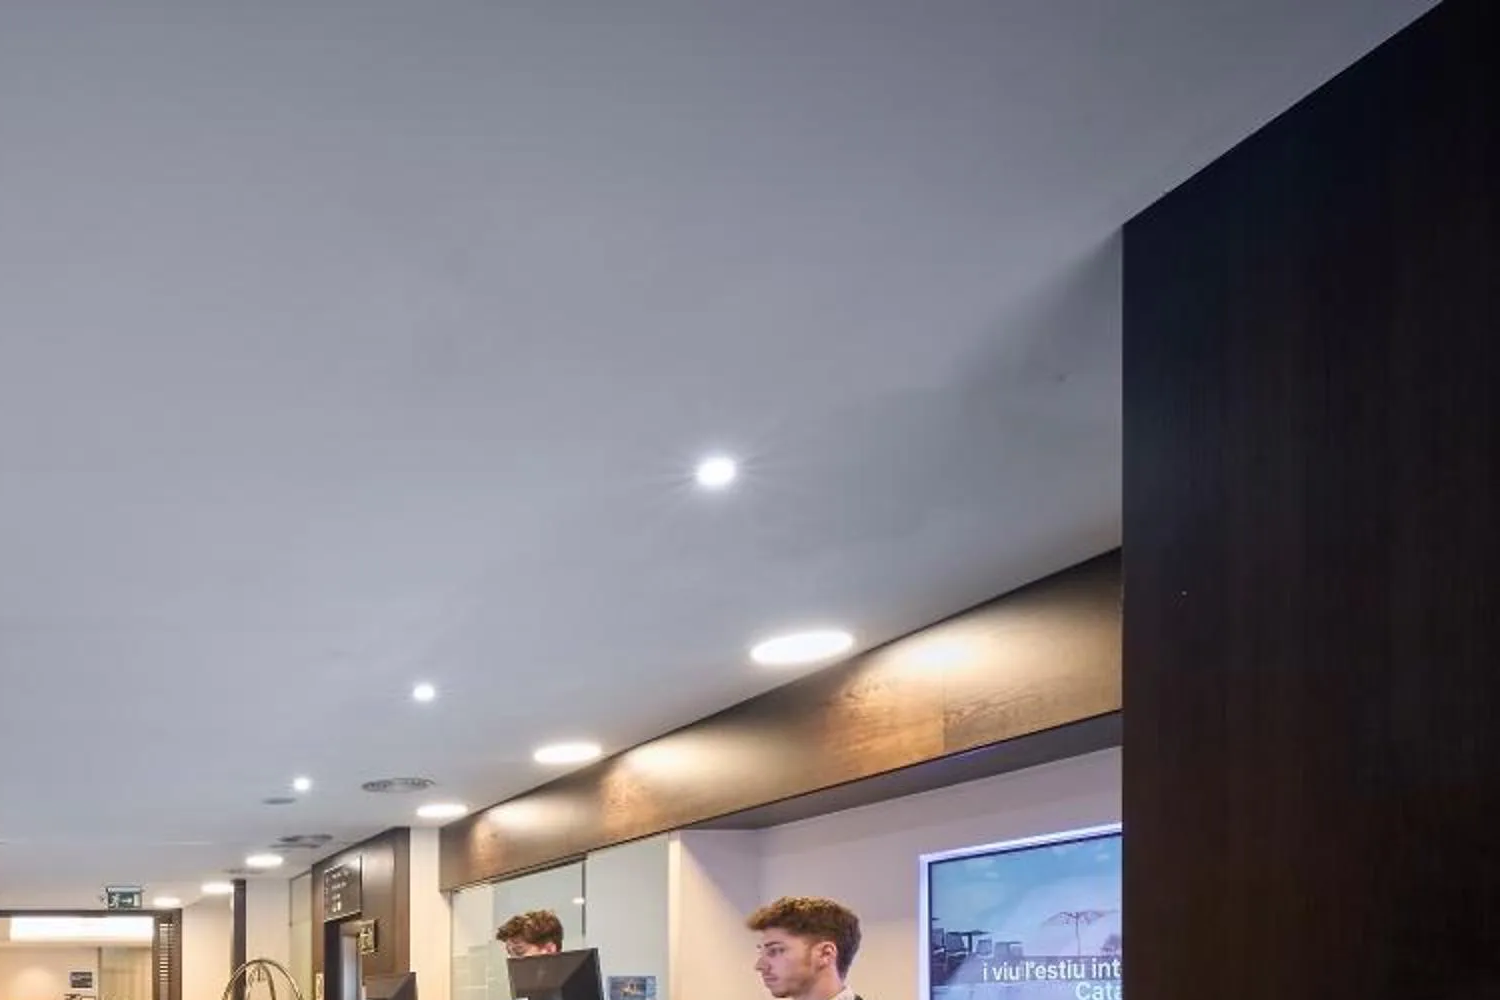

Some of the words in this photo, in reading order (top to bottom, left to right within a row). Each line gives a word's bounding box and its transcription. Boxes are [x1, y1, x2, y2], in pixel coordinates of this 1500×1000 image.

[983, 962, 988, 981] i
[992, 962, 1019, 981] viu
[1025, 960, 1085, 980] l'estiu
